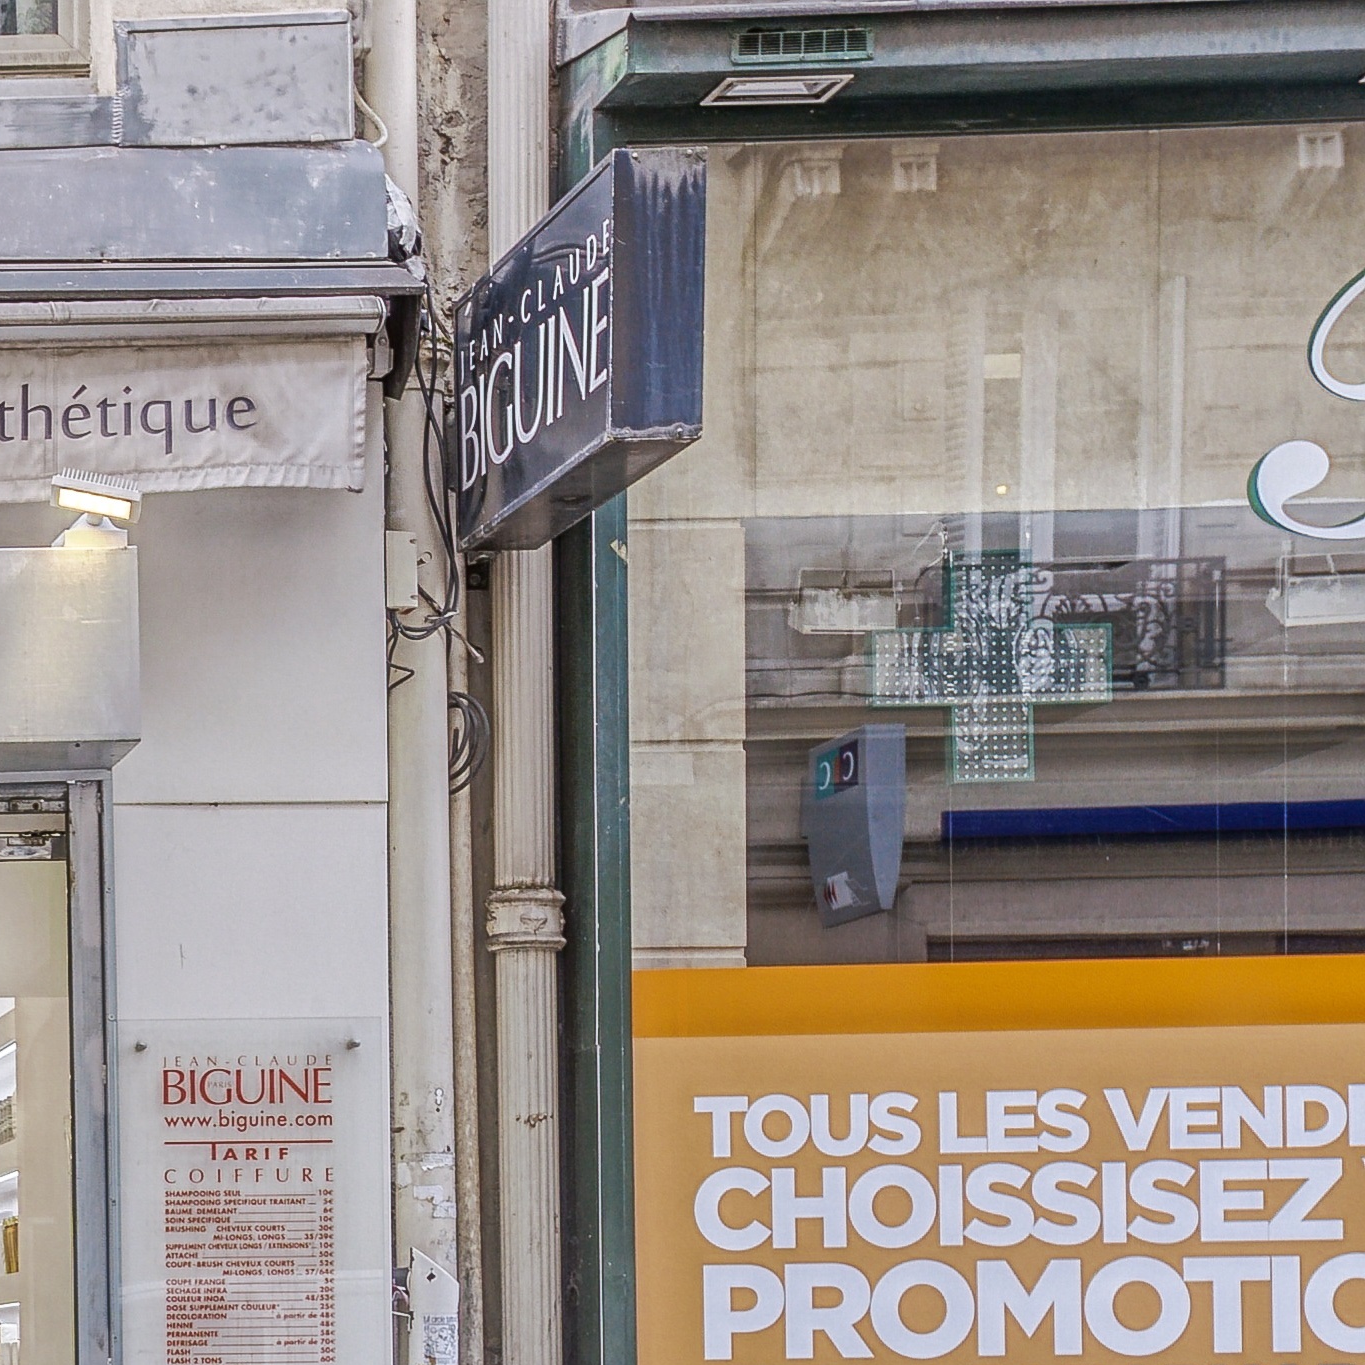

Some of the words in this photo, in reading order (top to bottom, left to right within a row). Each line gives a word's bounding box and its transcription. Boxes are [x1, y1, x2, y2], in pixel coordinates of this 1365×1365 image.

[460, 219, 610, 384] JEAN-CLAUDE
[461, 267, 608, 492] BIGUINE
[163, 1055, 332, 1067] JEAN-CLAUDE
[163, 1068, 332, 1105] BIGUINE
[164, 1109, 333, 1132] www.biguine.com
[694, 1092, 922, 1157] TOUS
[940, 1089, 1089, 1154] LES
[1104, 1084, 1365, 1152] VEND
[210, 1143, 289, 1161] TARIF
[164, 1167, 334, 1184] COIFFURE
[694, 1157, 1344, 1251] CHOISSISEZ
